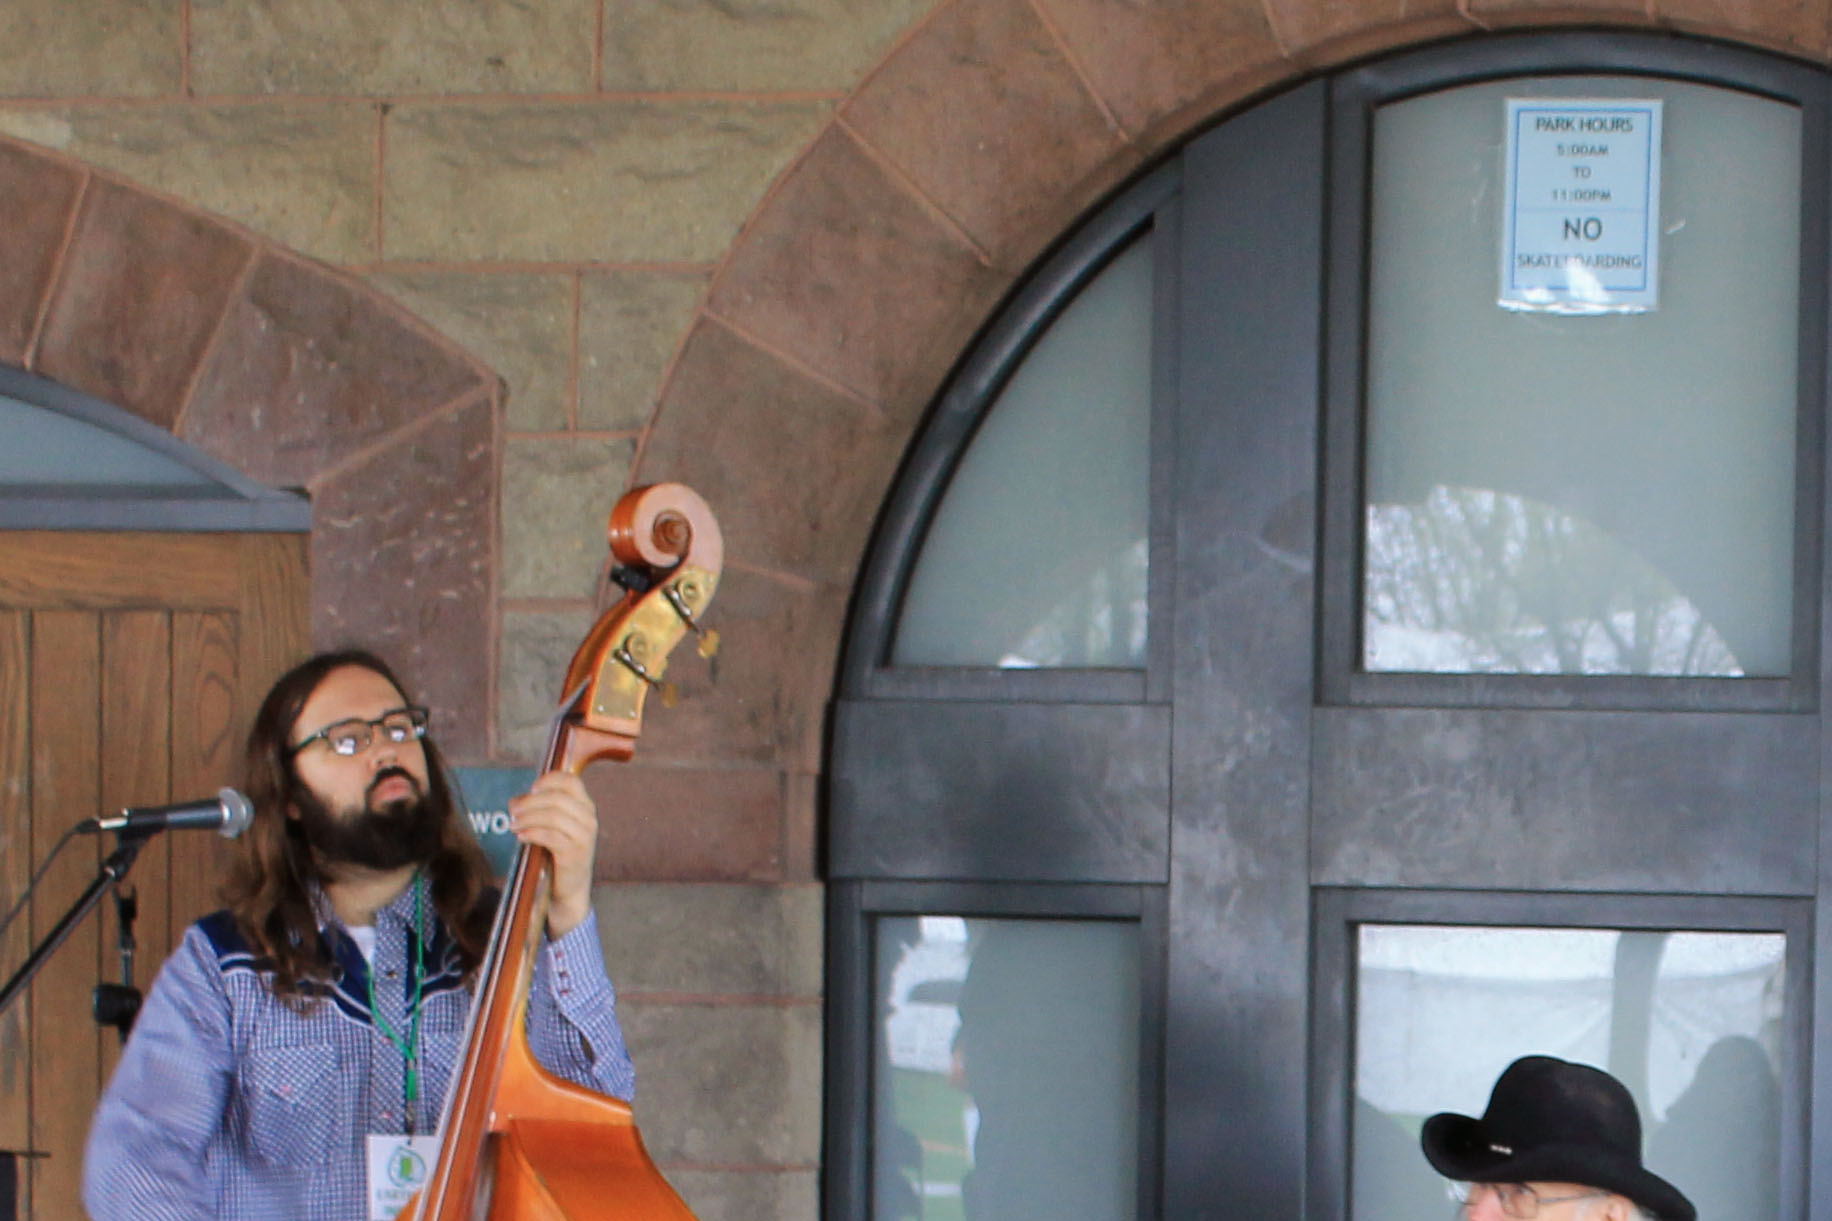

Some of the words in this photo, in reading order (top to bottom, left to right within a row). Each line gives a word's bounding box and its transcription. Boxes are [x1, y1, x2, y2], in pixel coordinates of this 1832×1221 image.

[1535, 117, 1575, 132] PARK
[1580, 117, 1633, 132] HOURS
[1571, 166, 1591, 179] TO
[1563, 217, 1603, 240] NO
